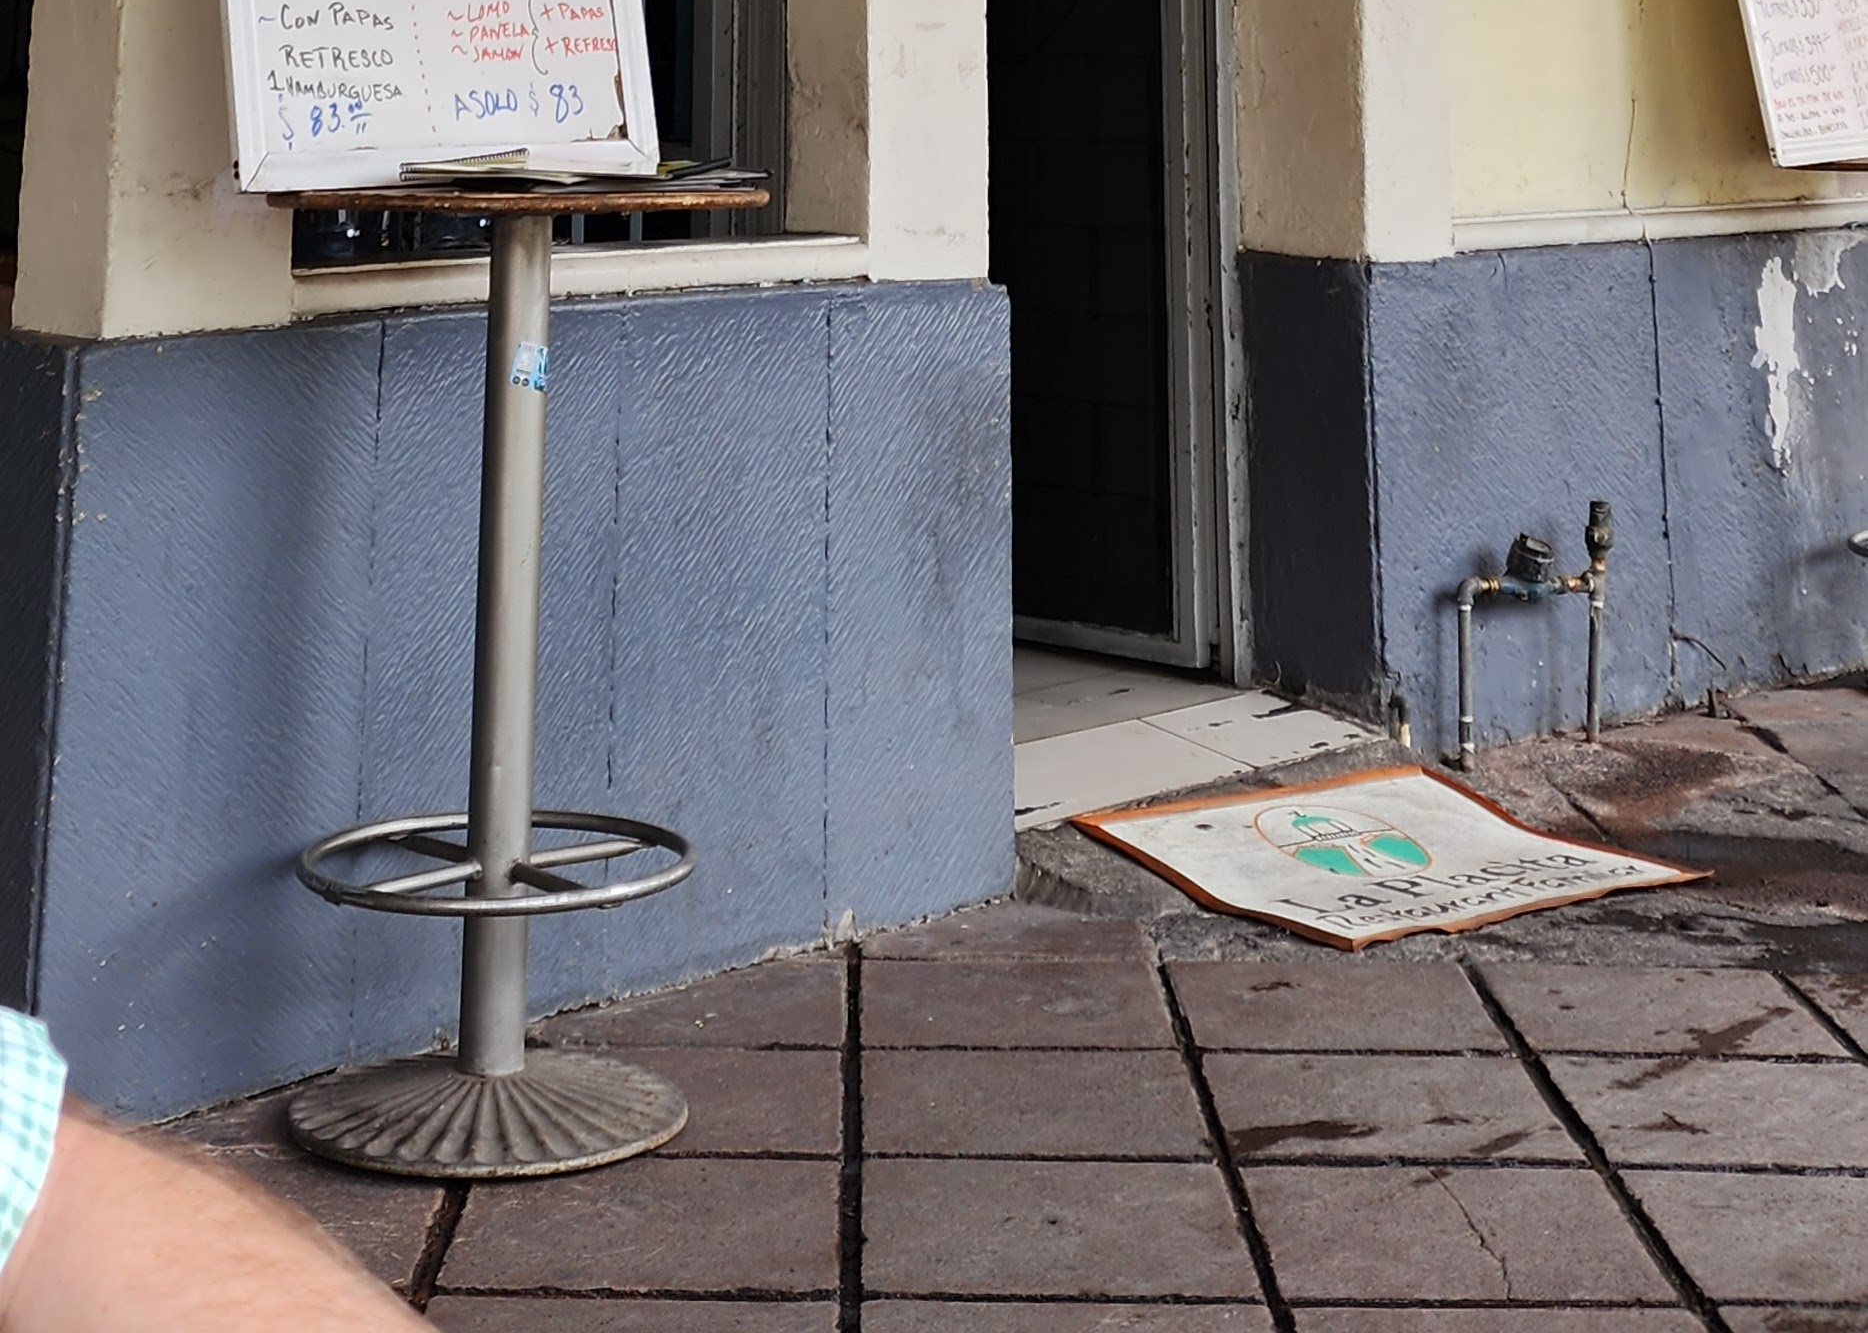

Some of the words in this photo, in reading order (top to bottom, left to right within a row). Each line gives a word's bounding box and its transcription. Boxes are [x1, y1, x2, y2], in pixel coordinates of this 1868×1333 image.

[328, 2, 395, 31] PAPAS
[466, 0, 511, 23] LOMO
[557, 2, 605, 21] PAPAS
[469, 22, 530, 44] PANELA
[285, 75, 404, 103] HAMBURGUESA
[1274, 893, 1393, 915] La
[1363, 853, 1598, 900] Placita
